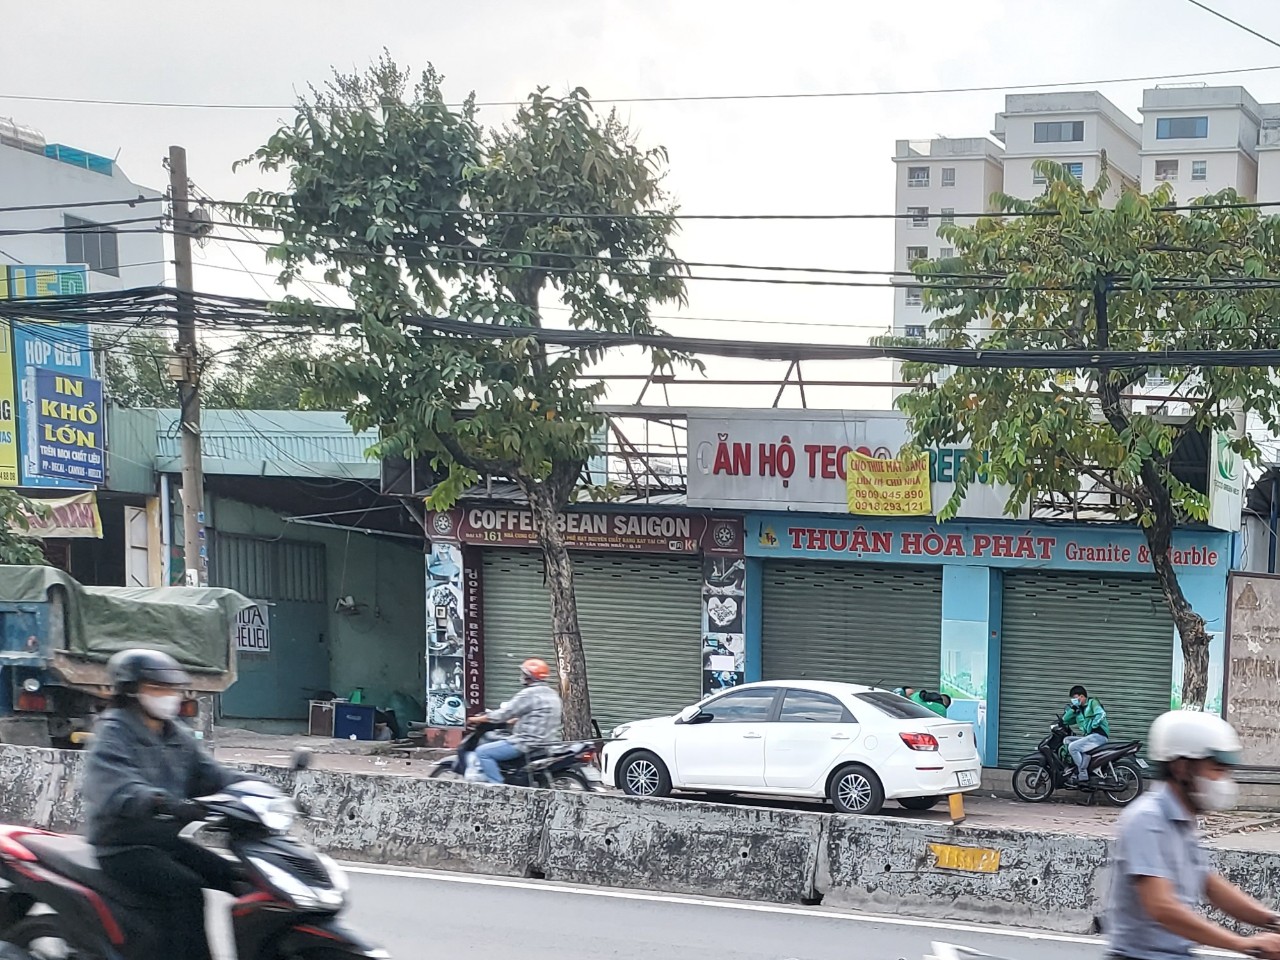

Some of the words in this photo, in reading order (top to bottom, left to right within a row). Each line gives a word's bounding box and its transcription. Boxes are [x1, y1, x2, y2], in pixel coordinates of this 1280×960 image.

[55, 376, 83, 398] IN
[45, 424, 95, 449] LỚN
[759, 435, 796, 488] HỘ
[855, 489, 924, 499] 0909.045.890
[855, 501, 923, 511] 0918.293.121
[483, 531, 503, 542] 161
[613, 514, 690, 538] SAIGON
[788, 525, 893, 558] THUẬN
[900, 527, 966, 557] HÒA
[972, 529, 1056, 560] PHÁT
[1065, 542, 1131, 563] Granite
[1136, 544, 1150, 564] &
[1167, 546, 1218, 567] arble
